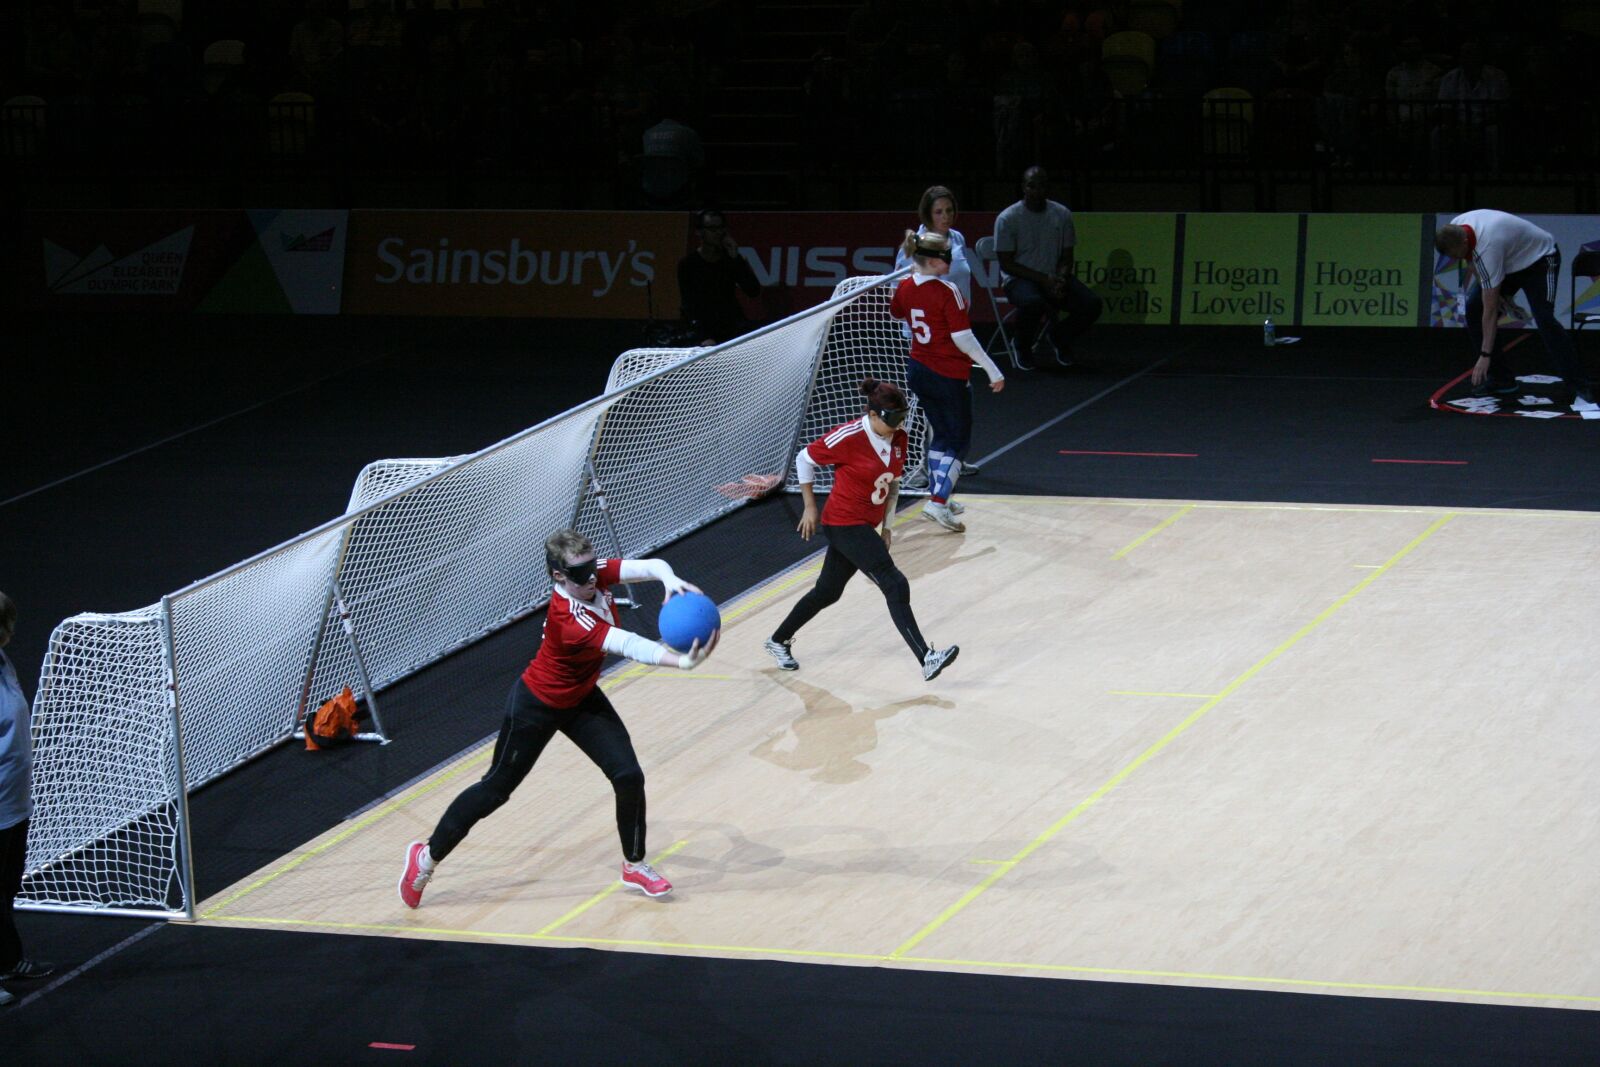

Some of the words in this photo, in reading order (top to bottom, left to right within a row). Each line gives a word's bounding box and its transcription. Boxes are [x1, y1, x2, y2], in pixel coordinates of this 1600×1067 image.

[142, 252, 183, 265] QUEEN
[375, 237, 656, 298] Sainsbury's
[87, 279, 138, 292] OLYMPIC
[141, 279, 176, 291] PARK
[112, 267, 180, 279] ELIZABETH
[1073, 260, 1157, 291] Hogan
[1193, 261, 1279, 292] Hogan
[1314, 262, 1403, 293] Hogan
[1191, 291, 1285, 316] Lovells
[1312, 291, 1409, 317] Lovells
[910, 308, 932, 345] 5
